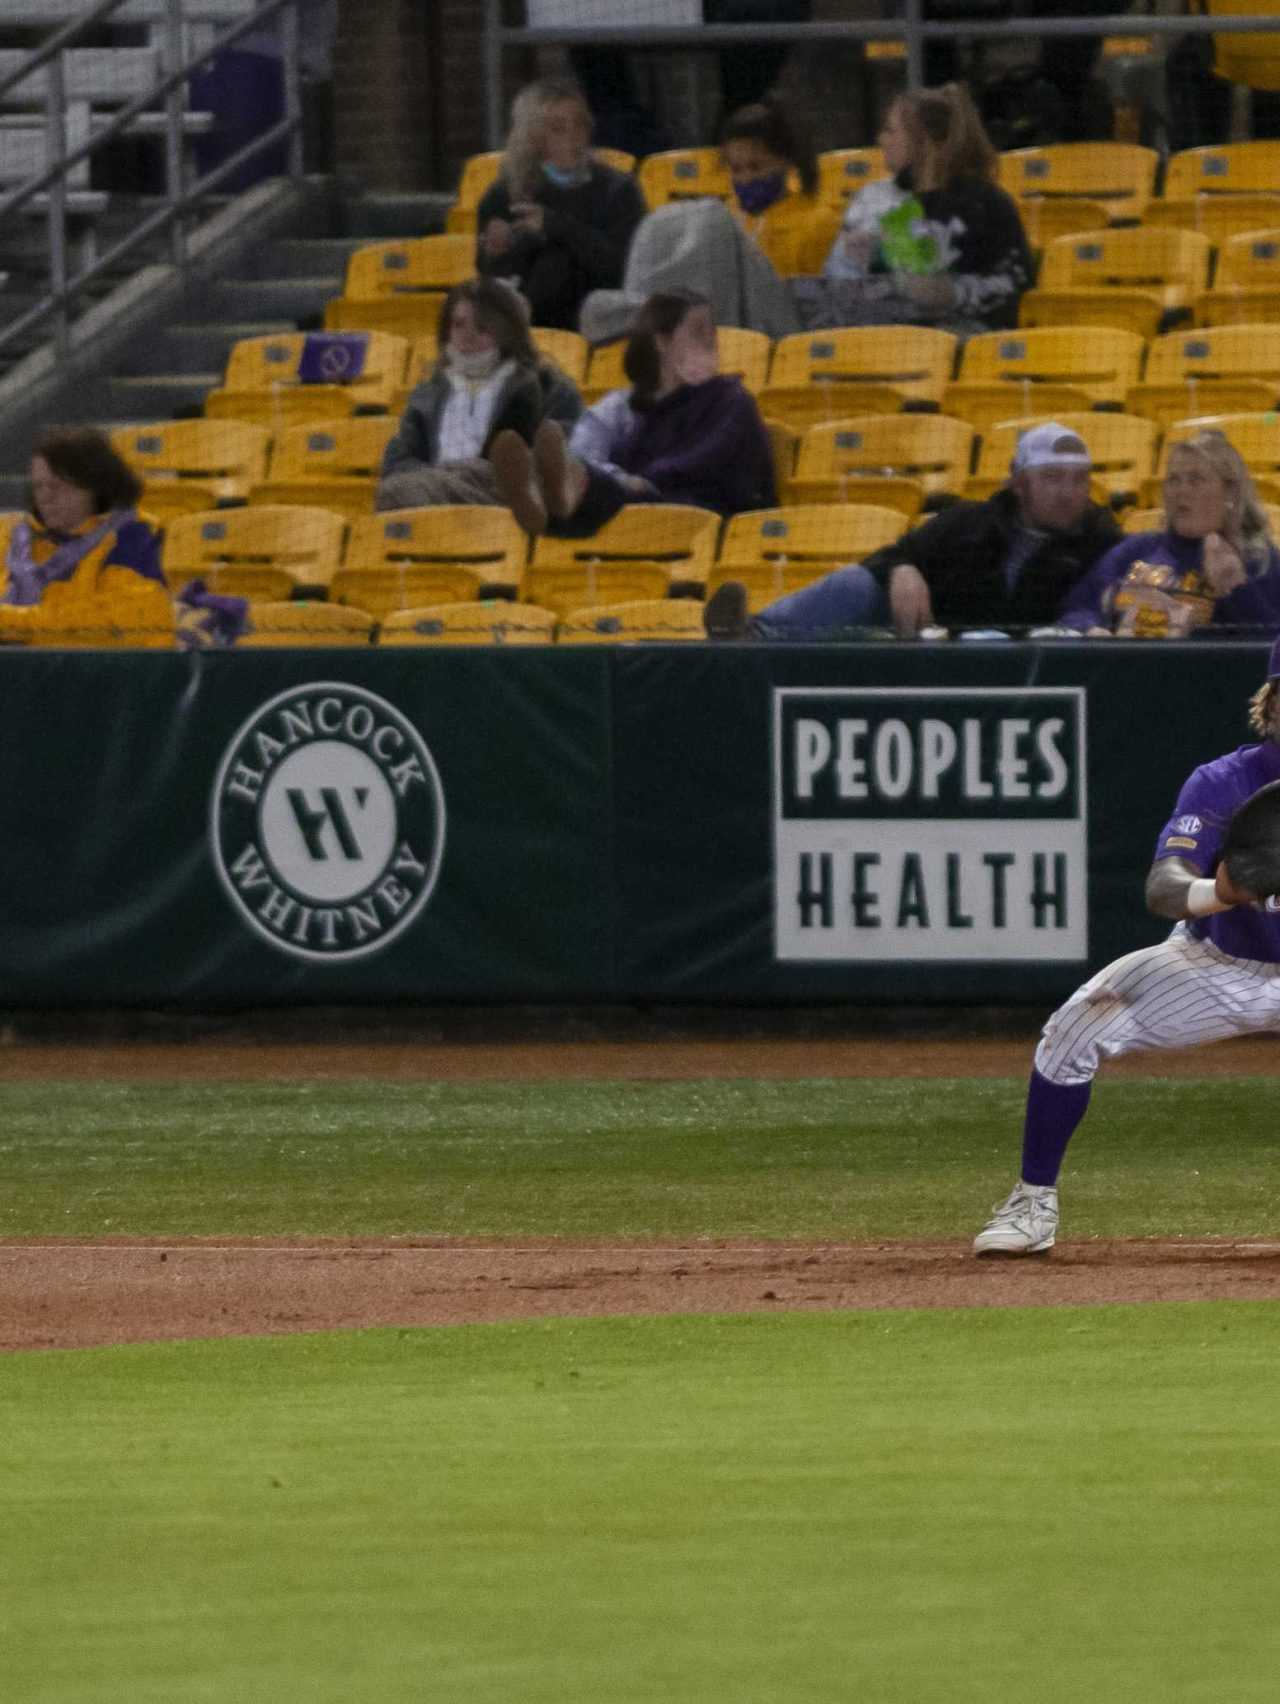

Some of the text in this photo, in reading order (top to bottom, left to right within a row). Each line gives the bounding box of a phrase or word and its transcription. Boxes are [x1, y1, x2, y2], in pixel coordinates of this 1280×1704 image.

[229, 698, 426, 803] HANCOCK
[794, 718, 1069, 798] PEOPLES
[230, 843, 427, 944] WHITNEY
[797, 852, 1069, 928] HEALTH
